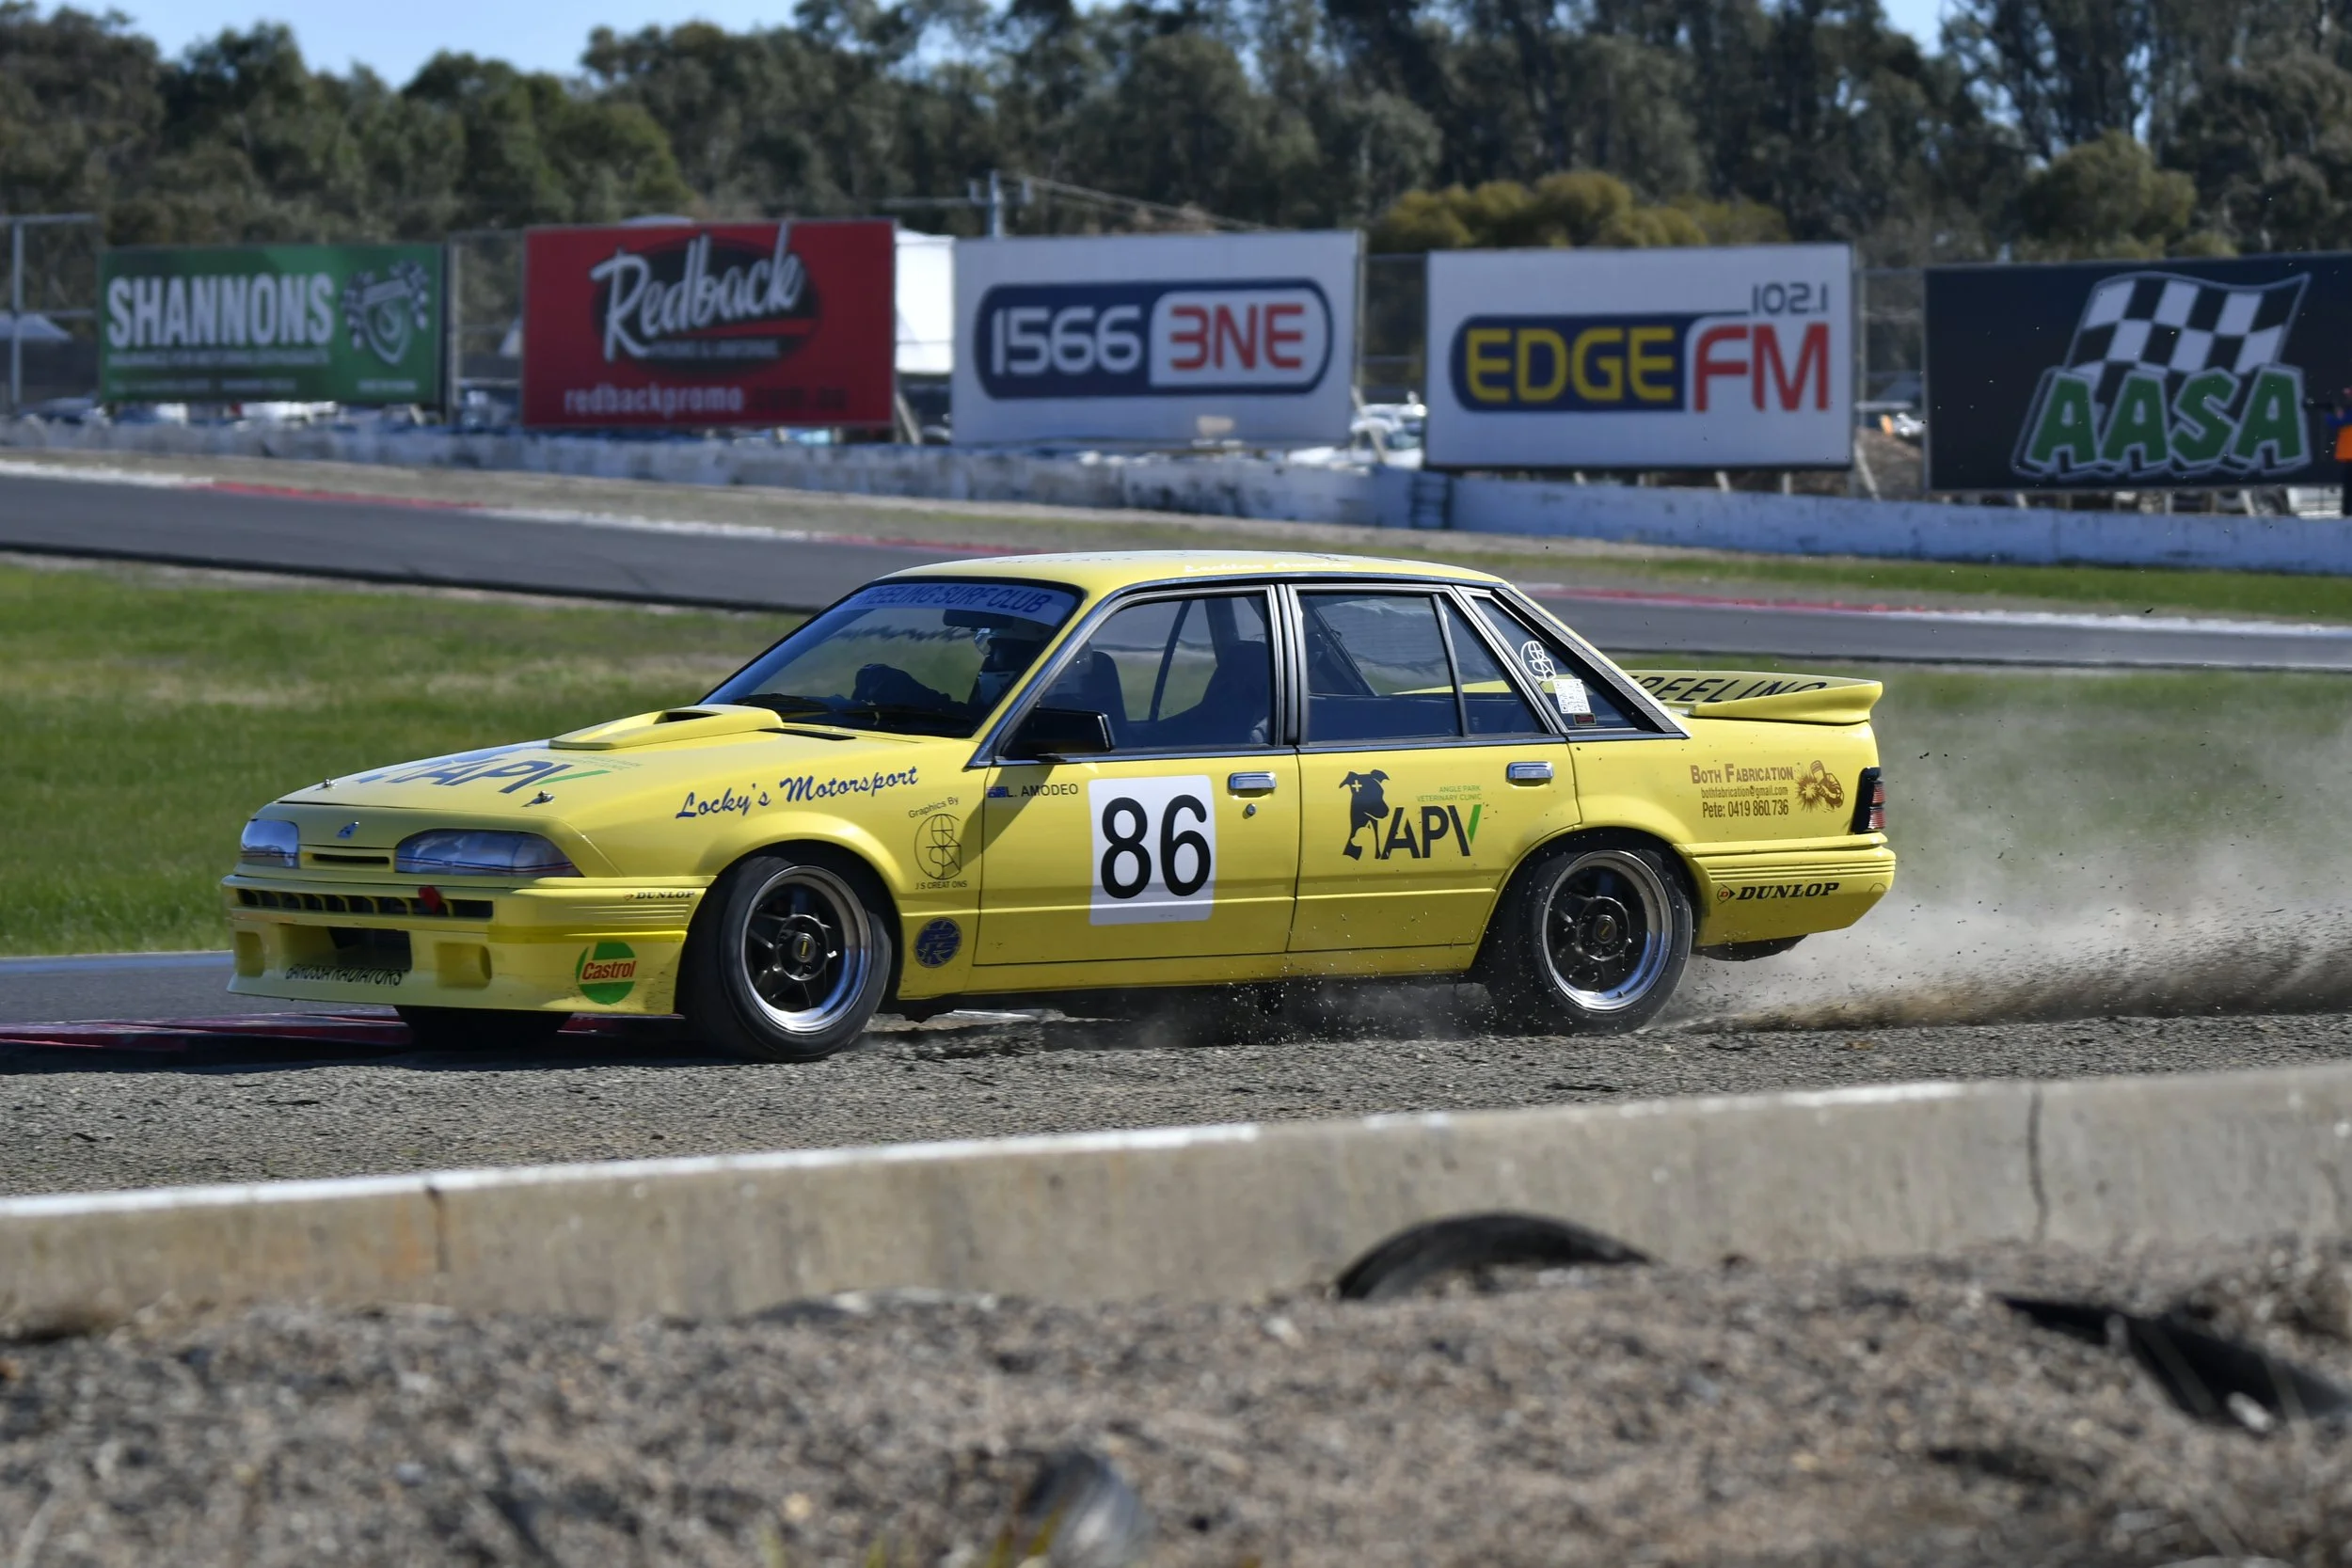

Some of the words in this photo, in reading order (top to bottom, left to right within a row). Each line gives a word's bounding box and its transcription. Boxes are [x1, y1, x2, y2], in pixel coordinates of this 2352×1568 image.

[591, 221, 805, 362] Redback
[1752, 282, 1828, 315] 102.1
[106, 272, 334, 347] SHANNONS
[992, 305, 1142, 375] 1566
[1170, 303, 1305, 371] 3NE
[1465, 325, 1676, 403] EDGE
[1693, 323, 1830, 412] FM
[2023, 365, 2311, 467] AASA
[987, 589, 1052, 613] CLUB
[1724, 763, 1794, 783] FABRICATION
[675, 782, 771, 818] Locky's
[779, 766, 919, 803] Motorsport
[908, 800, 946, 818] Graphics
[947, 796, 959, 807] By
[1021, 783, 1079, 798] AMODEO
[1702, 801, 1725, 818] Pete:
[1727, 800, 1750, 817] 0419
[1100, 794, 1212, 899] 86
[1380, 803, 1483, 860] APV
[635, 891, 695, 900] DUNLOP
[1736, 882, 1840, 900] DUNLOP
[581, 960, 637, 980] Castrol
